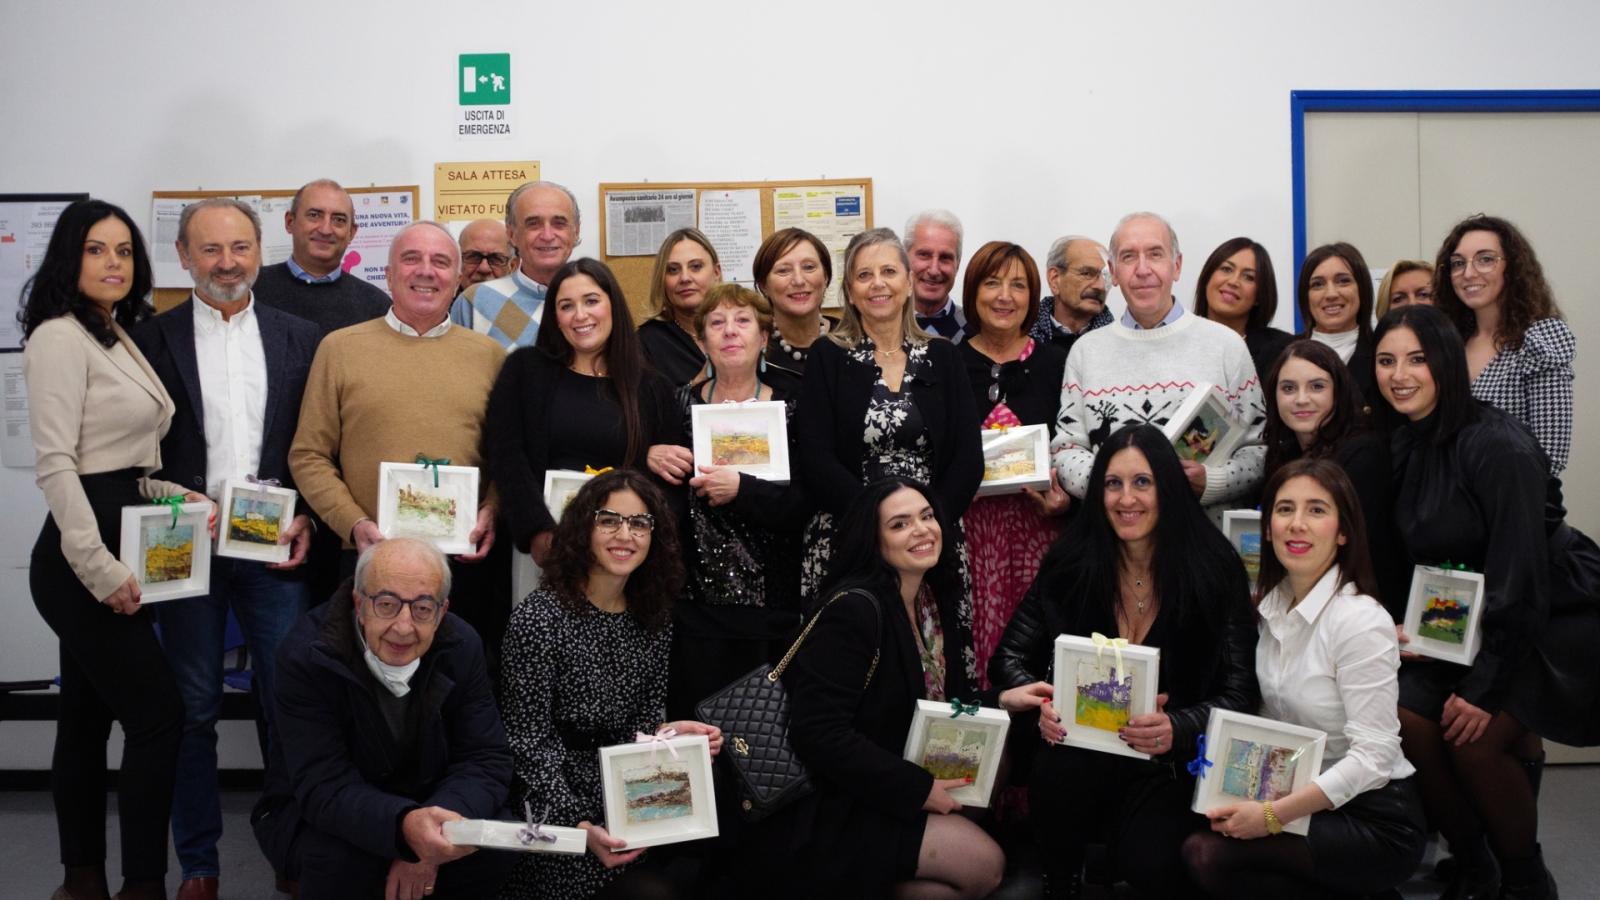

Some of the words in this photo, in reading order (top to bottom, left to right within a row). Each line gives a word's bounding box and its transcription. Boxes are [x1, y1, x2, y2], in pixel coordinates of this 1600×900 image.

[465, 110, 494, 121] USCITA
[496, 110, 505, 121] DI
[458, 124, 510, 135] EMERGENZA
[448, 171, 478, 181] SALA
[483, 170, 527, 180] ATTESA
[438, 204, 486, 215] VIETATO
